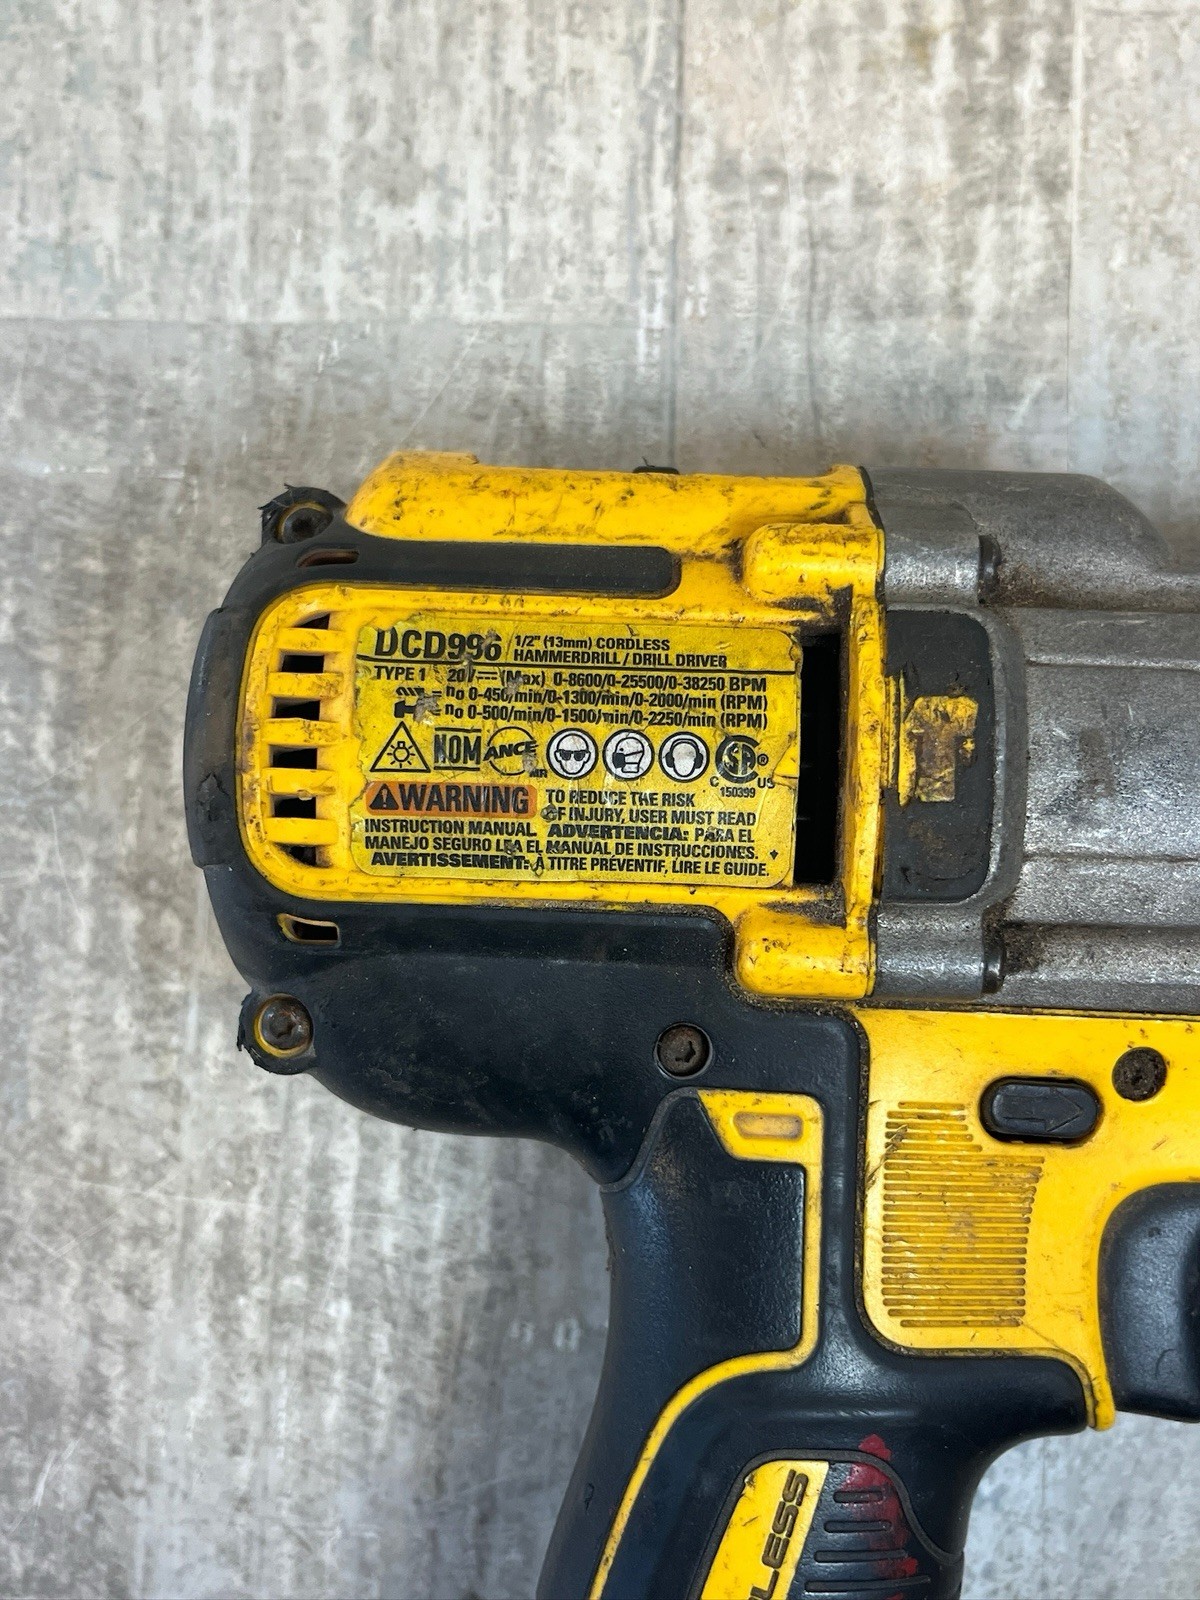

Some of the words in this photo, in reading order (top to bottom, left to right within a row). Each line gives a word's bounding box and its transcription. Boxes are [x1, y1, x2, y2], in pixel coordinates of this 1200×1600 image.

[374, 627, 502, 661] DCD996
[514, 635, 540, 647] 1/2"
[544, 636, 592, 650] (13mm)
[596, 638, 670, 651] CORDLESS
[513, 649, 620, 665] HAMMERDRILL
[632, 653, 672, 666] DRILL
[675, 654, 727, 668] DRIVER
[374, 666, 414, 681] TYPE
[419, 667, 426, 681] 1
[501, 670, 545, 687] (Max)
[553, 673, 725, 691] 0-8600/0-25500/0-38250
[729, 677, 767, 692] BPM
[721, 694, 768, 712] (RPM)
[720, 712, 768, 730] (RPM)
[434, 734, 481, 765] NOM
[483, 740, 539, 761] ANCE
[398, 784, 529, 814] WARNING
[546, 789, 565, 804] TO
[569, 790, 627, 806] REDUCE
[630, 791, 660, 806] THE
[662, 793, 696, 807] RISK
[720, 786, 756, 798] 150399
[569, 807, 625, 824] INJURY,
[629, 809, 667, 824] USER
[671, 810, 715, 825] MUST
[717, 812, 756, 826] READ
[364, 819, 464, 835] INSTRUCTION
[468, 821, 537, 837] MANUAL.
[547, 824, 689, 841] ADVERTENCIA:
[694, 828, 735, 843] PARA
[738, 829, 755, 843] EL
[365, 836, 429, 850] MANEJO
[433, 837, 491, 852] SEGURO
[527, 839, 543, 854] EL
[546, 840, 611, 855] MANUAL
[615, 843, 633, 856] DE
[637, 843, 759, 860] INSTRUCCIONES.
[371, 852, 530, 870] AVERTISSEMENT:
[549, 857, 587, 871] TITRE
[590, 855, 668, 874] PRÉVENTIF,
[672, 861, 700, 874] LIRE
[704, 862, 720, 875] LE
[723, 862, 770, 877] GUIDE.
[748, 1469, 809, 1600] LESS
